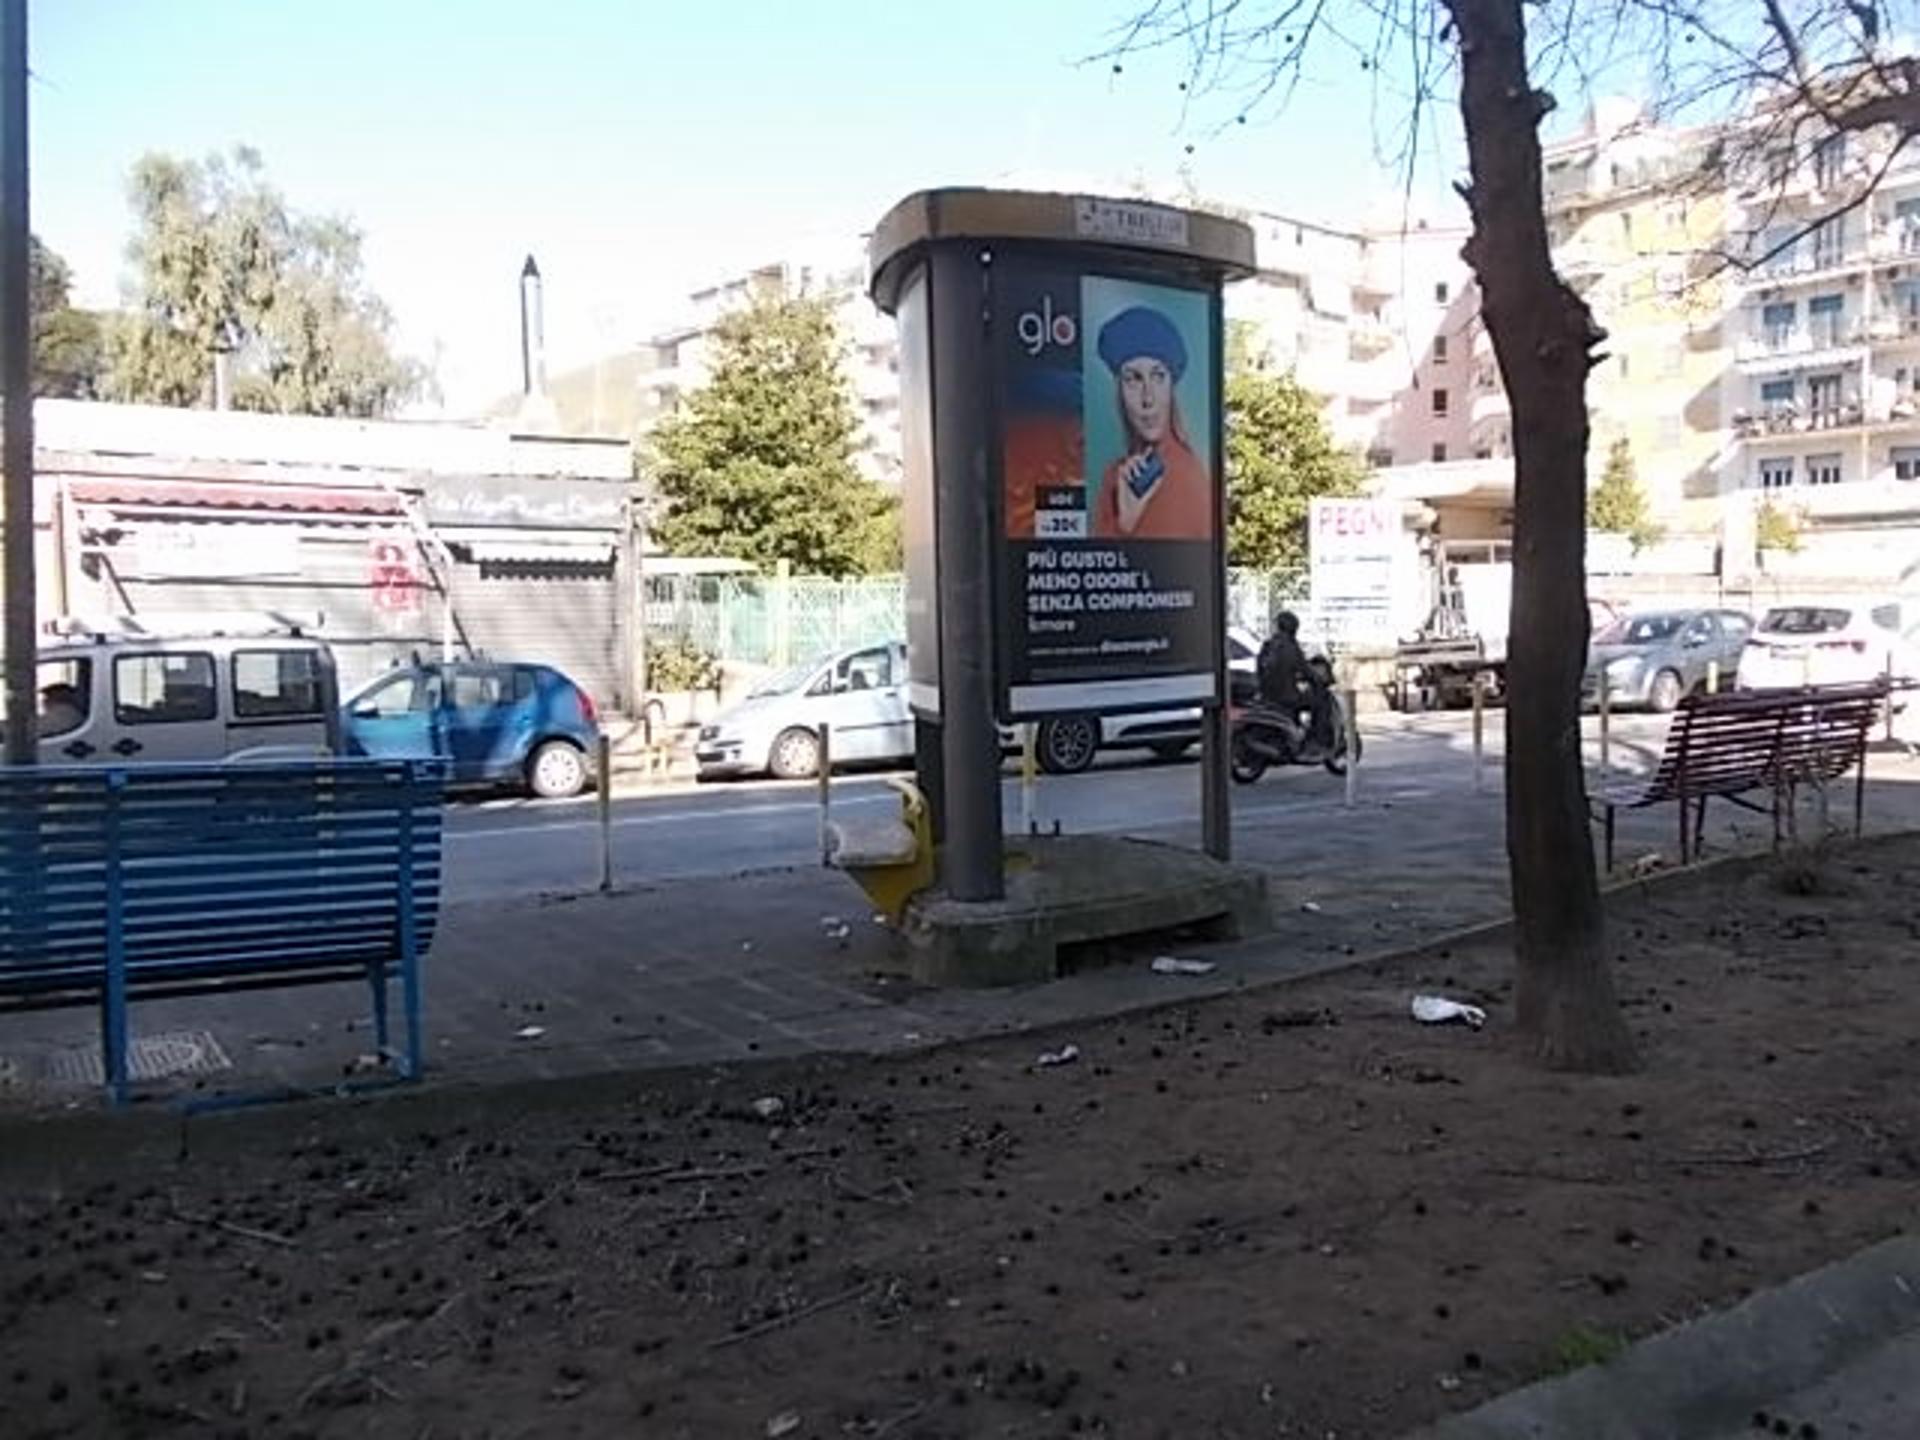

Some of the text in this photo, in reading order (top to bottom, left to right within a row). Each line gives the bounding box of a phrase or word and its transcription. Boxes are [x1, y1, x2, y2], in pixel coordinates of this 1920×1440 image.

[1018, 296, 1076, 355] glo
[1028, 547, 1057, 568] PIÙ
[1060, 550, 1117, 568] GUSTO
[1027, 572, 1081, 590] MENO
[1027, 592, 1084, 612] SENZA
